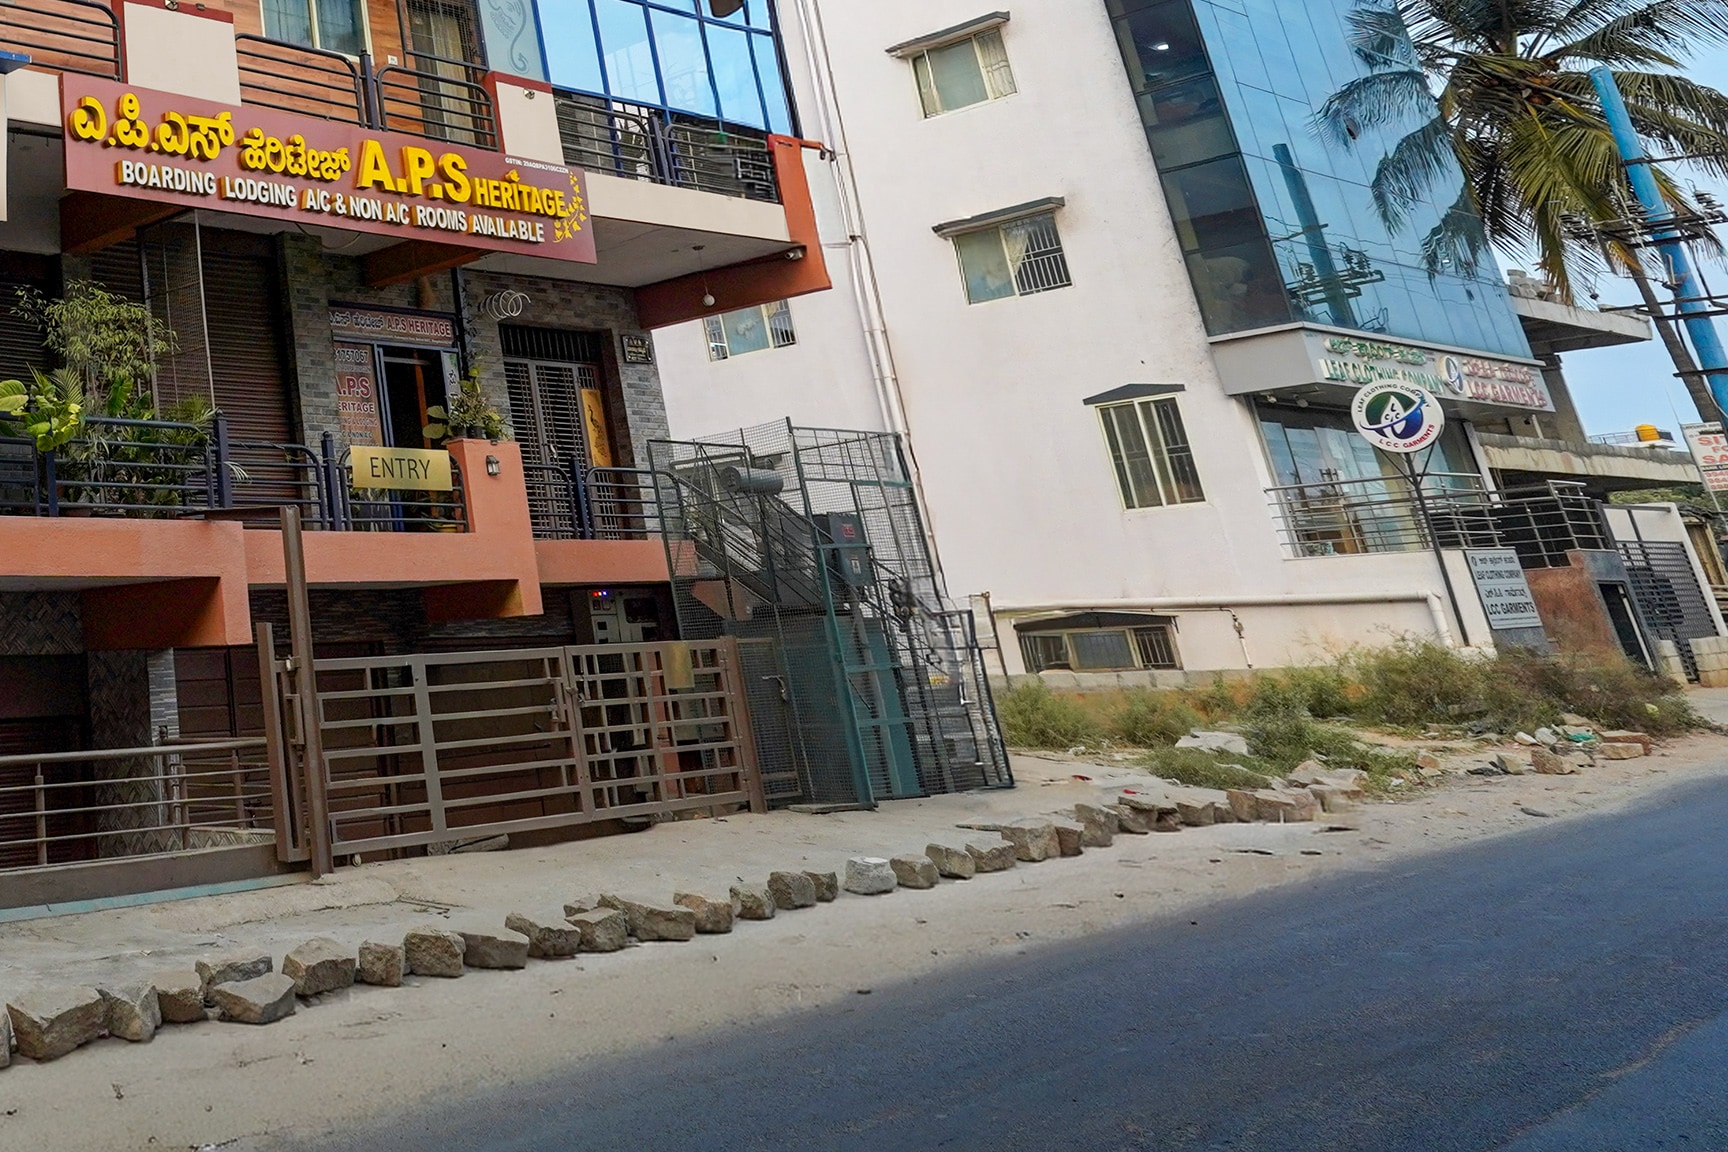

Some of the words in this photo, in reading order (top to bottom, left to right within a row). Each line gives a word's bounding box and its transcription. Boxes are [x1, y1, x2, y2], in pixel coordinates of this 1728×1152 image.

[357, 138, 472, 203] A.P.S
[119, 159, 217, 195] BOARDING
[222, 176, 297, 208] LODGING
[335, 199, 347, 216] &
[348, 195, 382, 220] NON
[415, 204, 468, 232] ROOMS
[471, 214, 545, 243] AVAILABLE
[408, 318, 452, 337] HERITAGE
[334, 347, 369, 363] 1757067
[1319, 358, 1350, 382] LEAF
[1463, 379, 1490, 401] LCC
[1490, 383, 1548, 408] GARMENTS
[338, 400, 376, 414] ERITAGE
[1403, 423, 1435, 448] GARMENTS
[370, 456, 431, 480] ENTRY
[1486, 603, 1501, 615] LCC
[1500, 601, 1536, 614] GARMENTS
